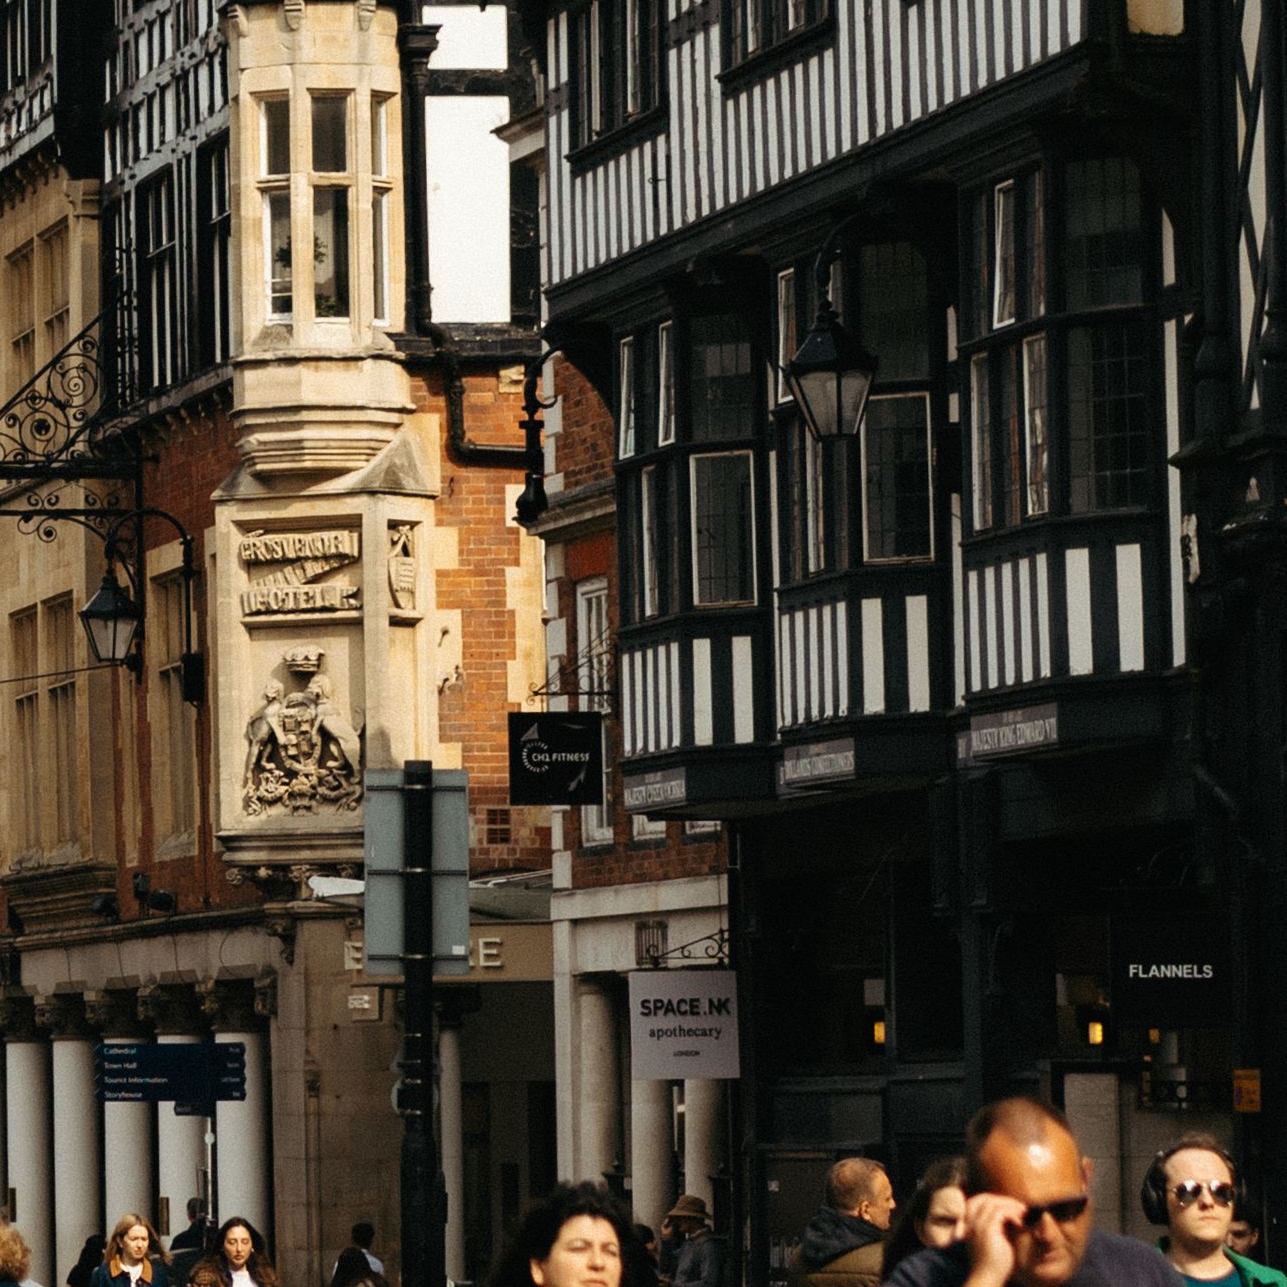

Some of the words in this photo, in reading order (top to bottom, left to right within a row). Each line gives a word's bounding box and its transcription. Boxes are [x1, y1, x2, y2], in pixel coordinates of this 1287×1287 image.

[531, 753, 550, 762] CH1
[552, 752, 590, 762] FITNESS
[1129, 964, 1213, 978] FLANNELS
[640, 998, 731, 1016] SPACE.NK
[649, 1025, 722, 1040] apothecary
[104, 1047, 137, 1055] Cathedral
